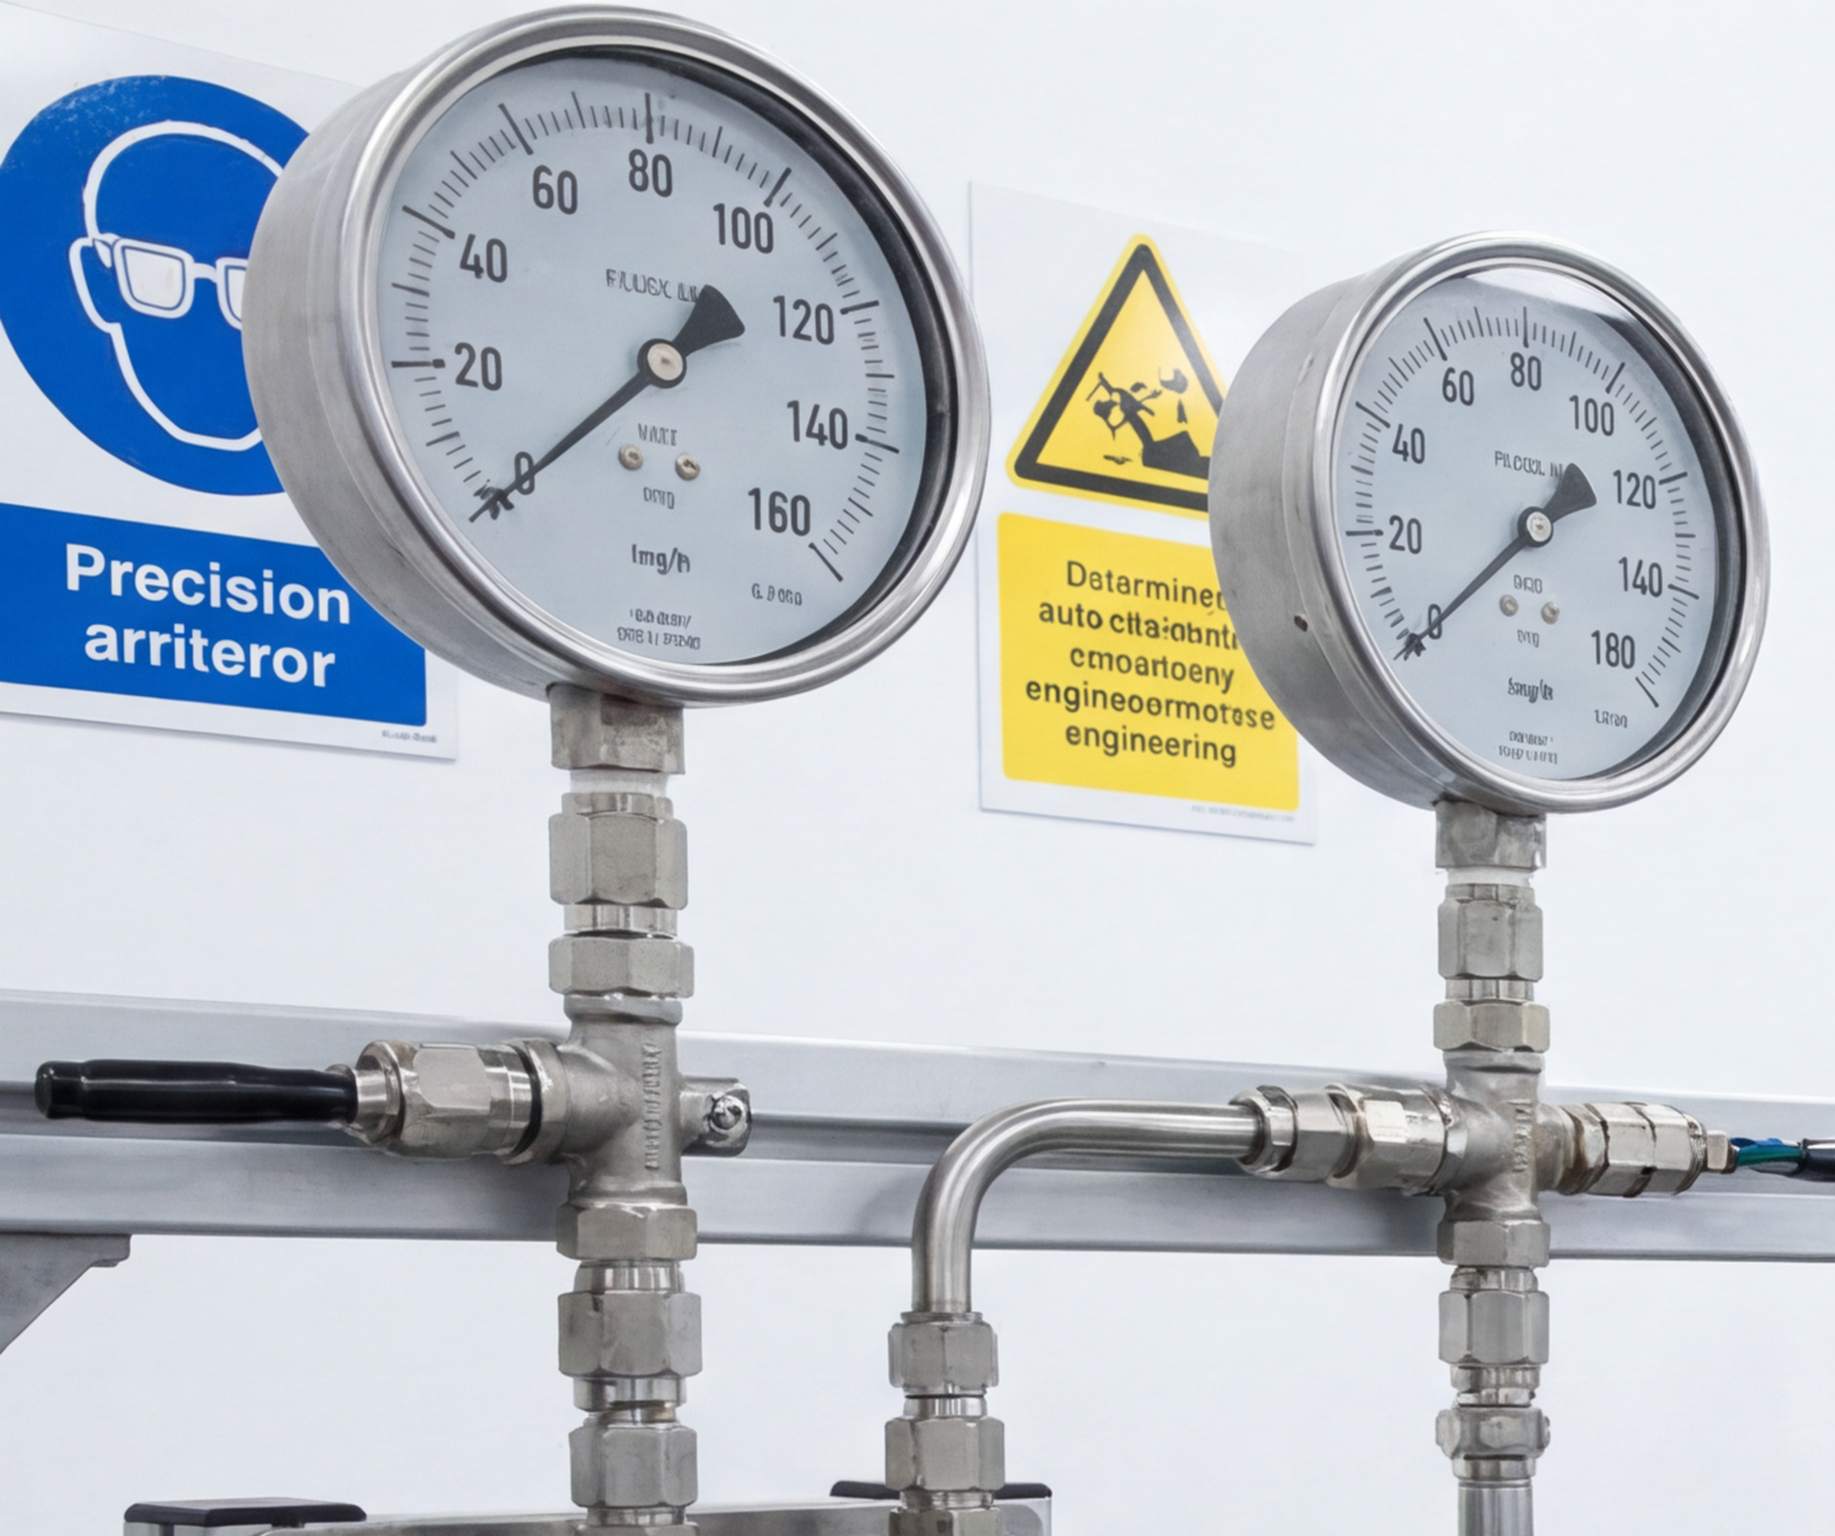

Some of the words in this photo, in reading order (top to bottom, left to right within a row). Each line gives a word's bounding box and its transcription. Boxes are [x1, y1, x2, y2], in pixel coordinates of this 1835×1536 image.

[532, 164, 578, 215] 60
[629, 148, 673, 198] 80
[713, 203, 774, 254] 100
[459, 233, 508, 283] 40
[773, 295, 834, 345] 120
[454, 342, 503, 391] 20
[1442, 366, 1474, 406] 60
[1510, 352, 1542, 391] 80
[787, 400, 848, 450] 140
[1569, 395, 1614, 436] 100
[1392, 424, 1425, 464] 40
[514, 451, 536, 496] 0
[1613, 470, 1656, 509] 120
[748, 487, 811, 537] 160
[1389, 515, 1422, 554] 20
[66, 543, 351, 625] Precision
[1618, 557, 1663, 597] 140
[1039, 601, 1103, 630] auto
[1427, 603, 1443, 640] 0
[84, 622, 336, 688] arriteror
[1591, 630, 1636, 669] 180
[1065, 724, 1237, 768] engineering
